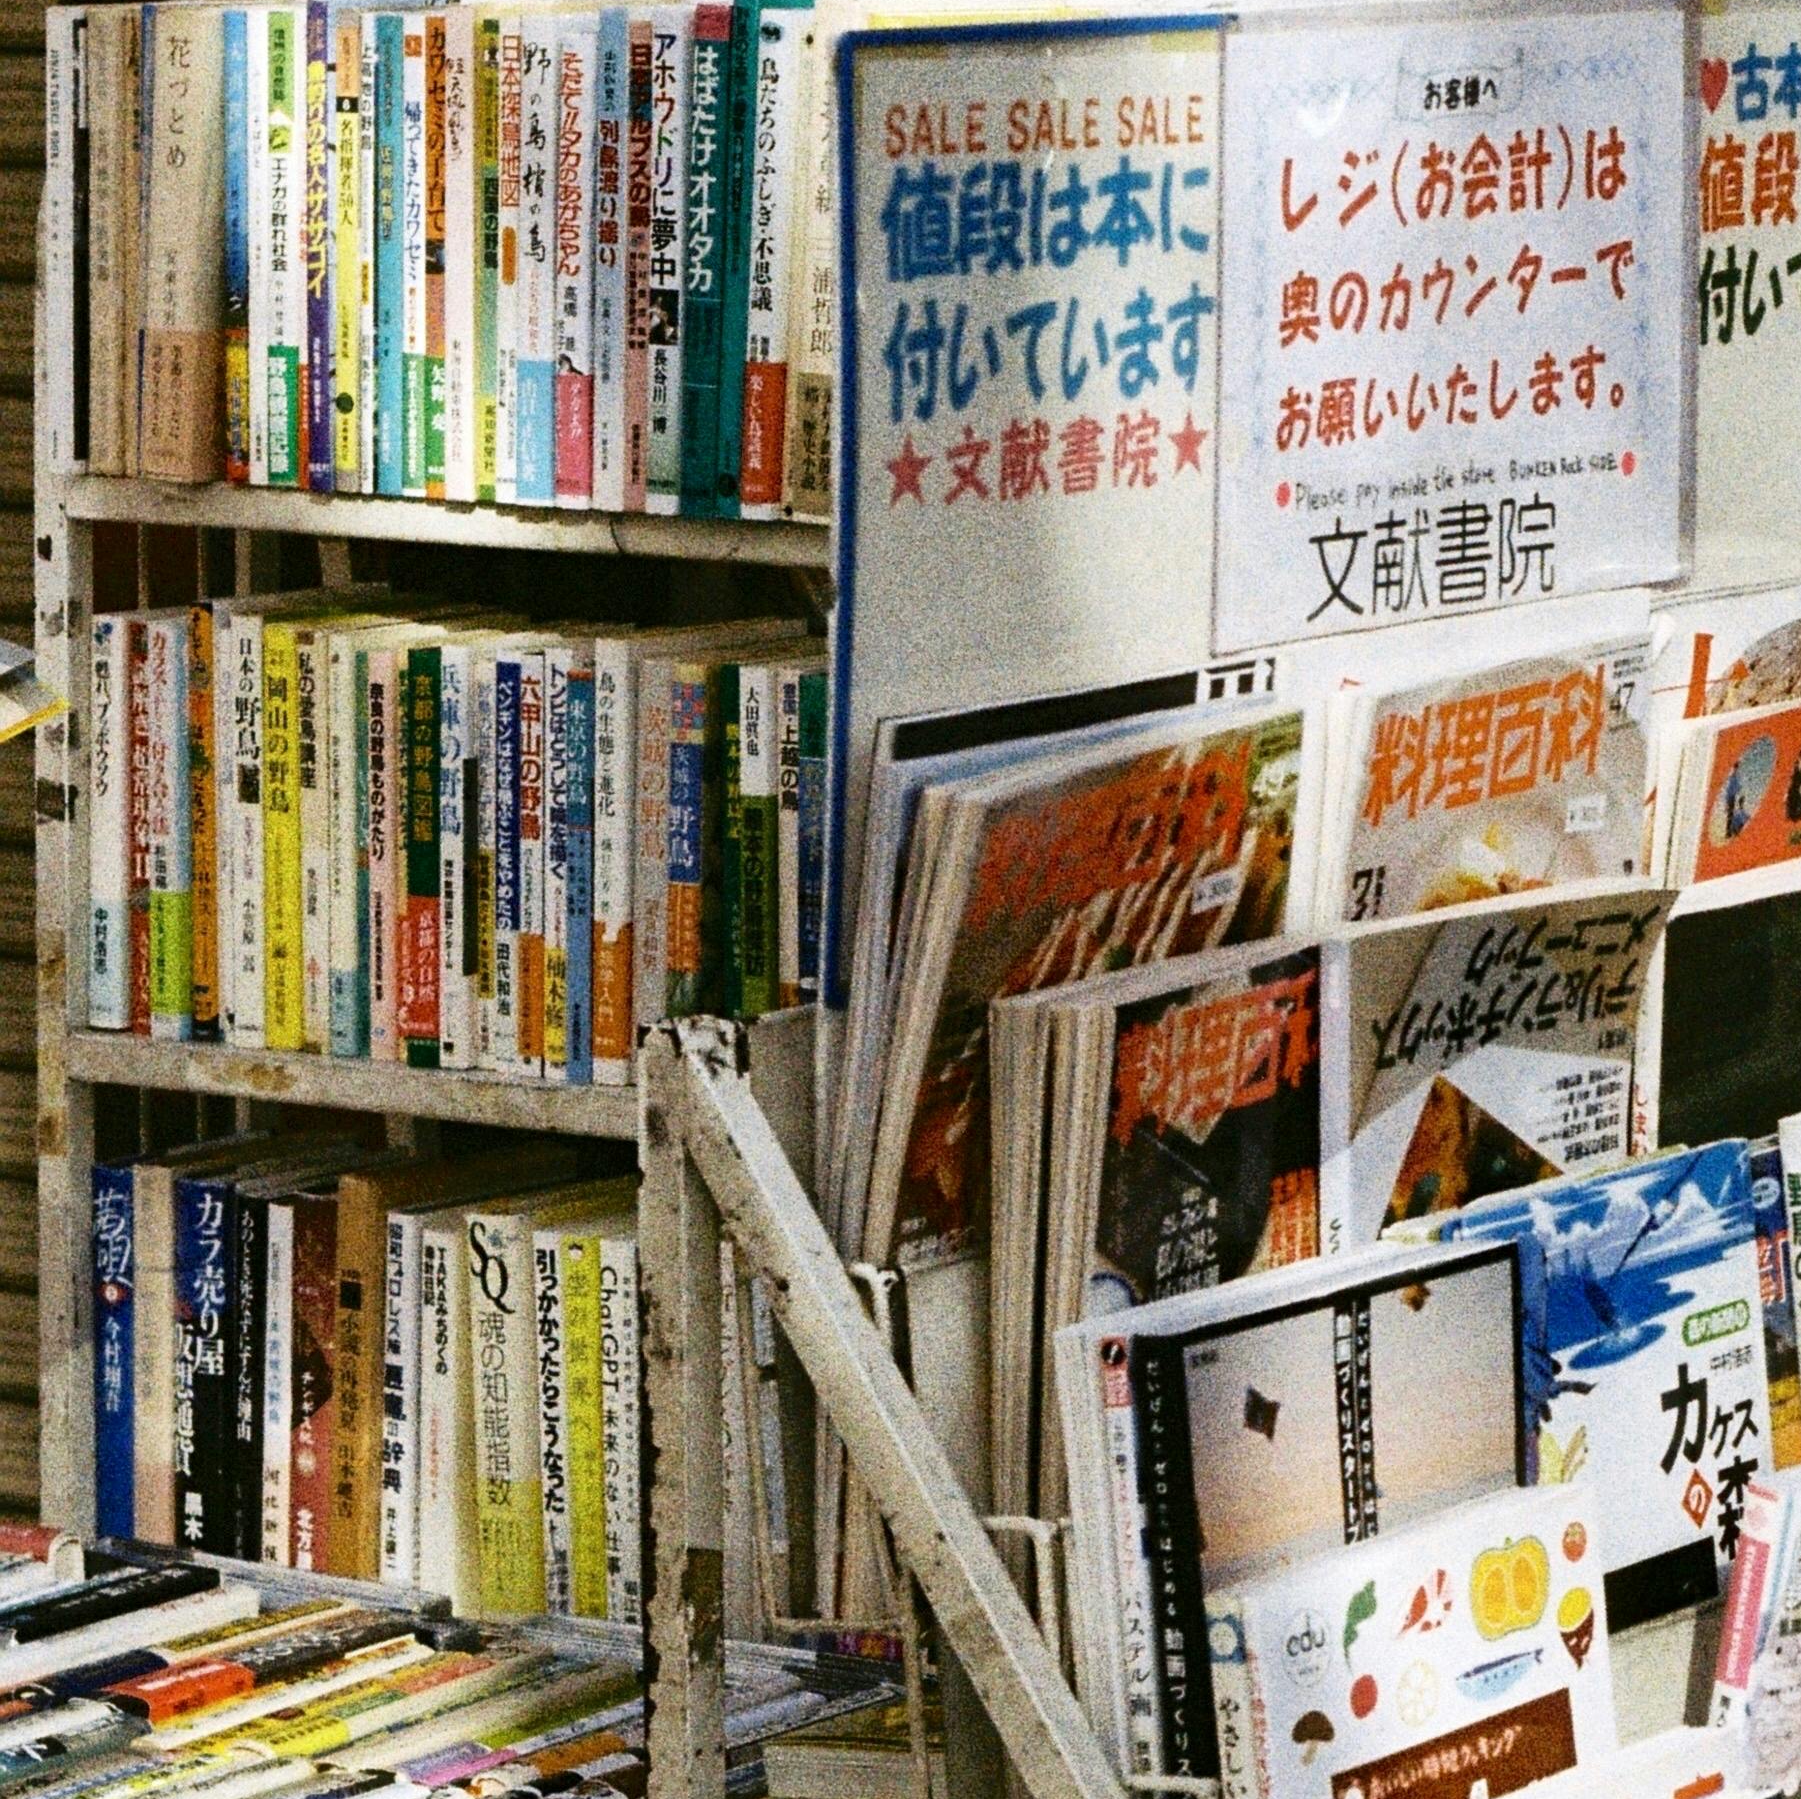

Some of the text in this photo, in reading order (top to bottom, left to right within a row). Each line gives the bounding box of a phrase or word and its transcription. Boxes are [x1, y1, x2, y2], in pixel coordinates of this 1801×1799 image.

[503, 35, 521, 207] 日本探鳥地図
[650, 32, 679, 287] アホウドリに夢中
[885, 99, 987, 160] SALE
[1007, 96, 1101, 155] SALE
[1118, 94, 1205, 147] SALE
[1422, 76, 1500, 111] お客様へ
[271, 157, 290, 273] エナガの群れ社会
[404, 101, 423, 280] 帰ってきたカワセミ
[687, 46, 721, 295] はばたけオオタカ
[880, 155, 1211, 283] 値段は本に
[1280, 122, 1627, 232] レジ(お会計)は
[882, 281, 1216, 425] 付いています
[1279, 239, 1635, 348] 奥のカウンターで
[943, 408, 1160, 506] 文献書院
[1275, 344, 1625, 452] お願いいたします。
[1294, 479, 1347, 511] Please
[1355, 480, 1380, 509] pay
[1305, 492, 1557, 624] 文献書院
[267, 676, 291, 813] 岡山の野鳥
[520, 673, 544, 843] 六甲山の野鳥
[1362, 664, 1607, 828] 料理百科
[194, 1194, 225, 1378] カラ売り屋
[478, 1311, 512, 1509] 魂の知能指数
[1658, 1363, 1759, 1474] カケス
